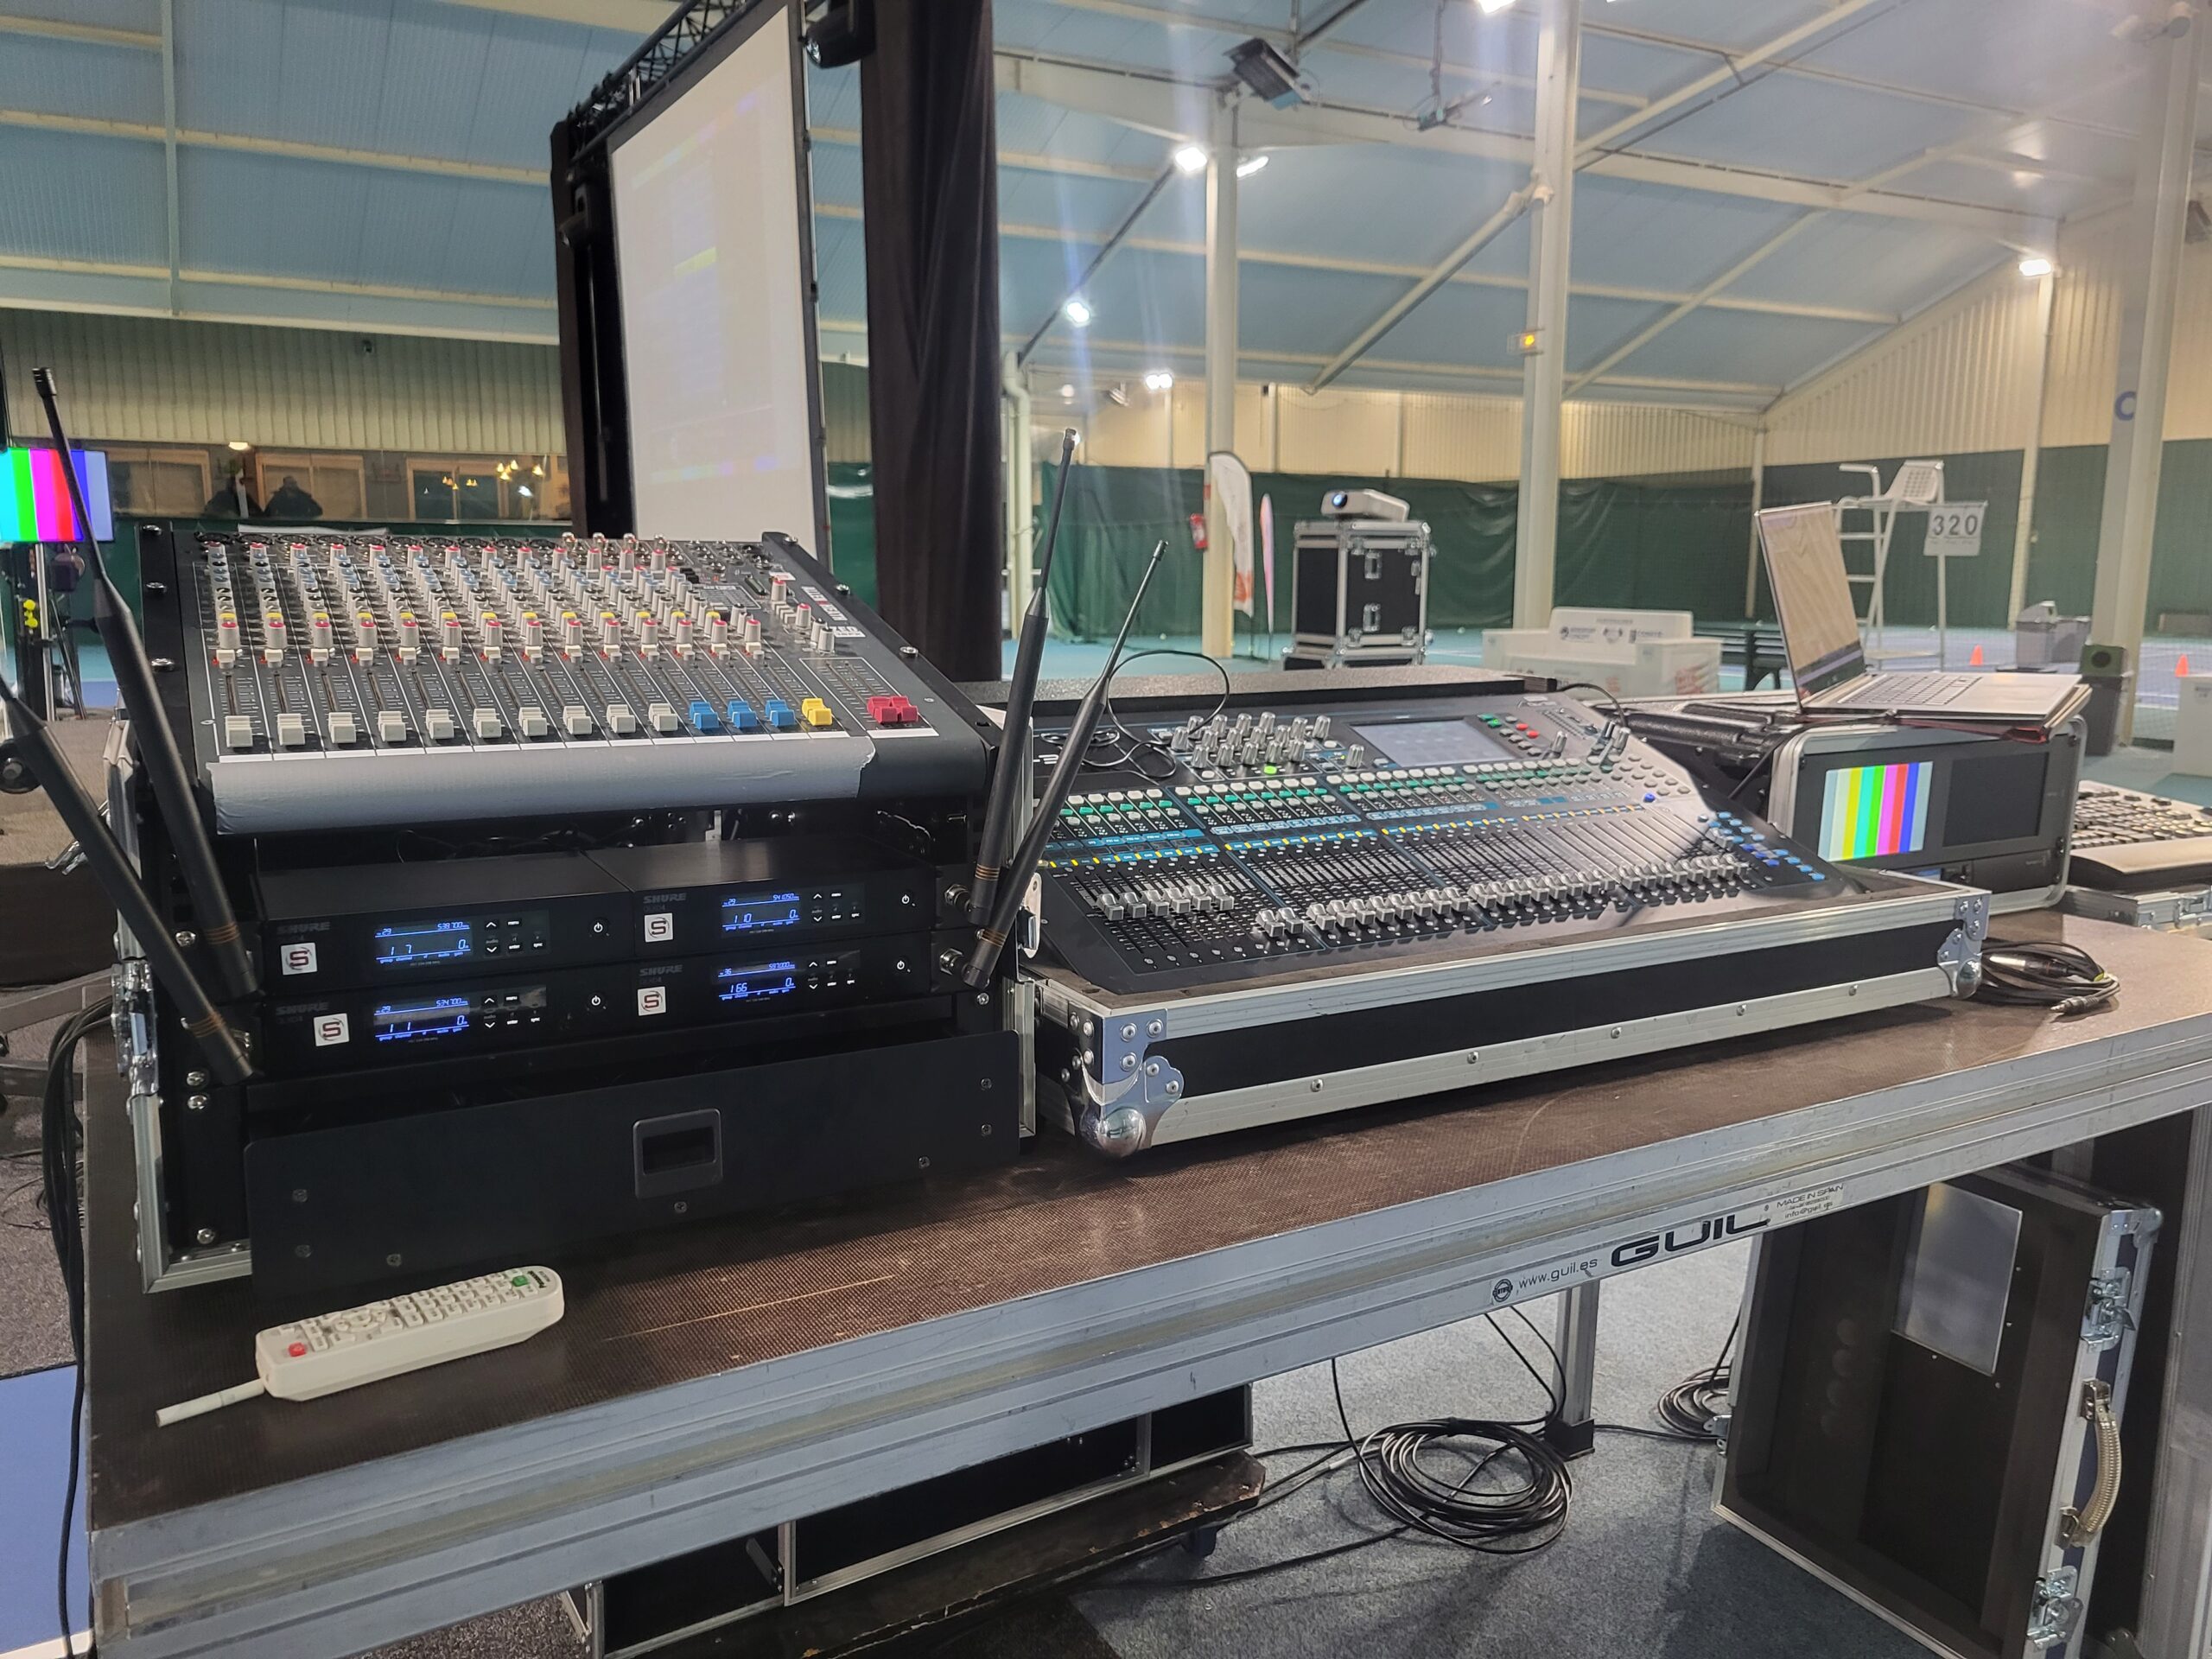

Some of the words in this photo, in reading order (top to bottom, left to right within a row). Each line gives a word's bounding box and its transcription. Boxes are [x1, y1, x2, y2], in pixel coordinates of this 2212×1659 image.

[1932, 514, 1978, 536] 320
[643, 893, 687, 904] SHURE
[639, 964, 683, 976] SHURE
[276, 1002, 328, 1015] SHURE
[1777, 1194, 1806, 1209] MADE
[1816, 1183, 1845, 1197] SPAIN
[1611, 1214, 1770, 1267] GUIL
[1519, 1258, 1598, 1289] www.guil.es
